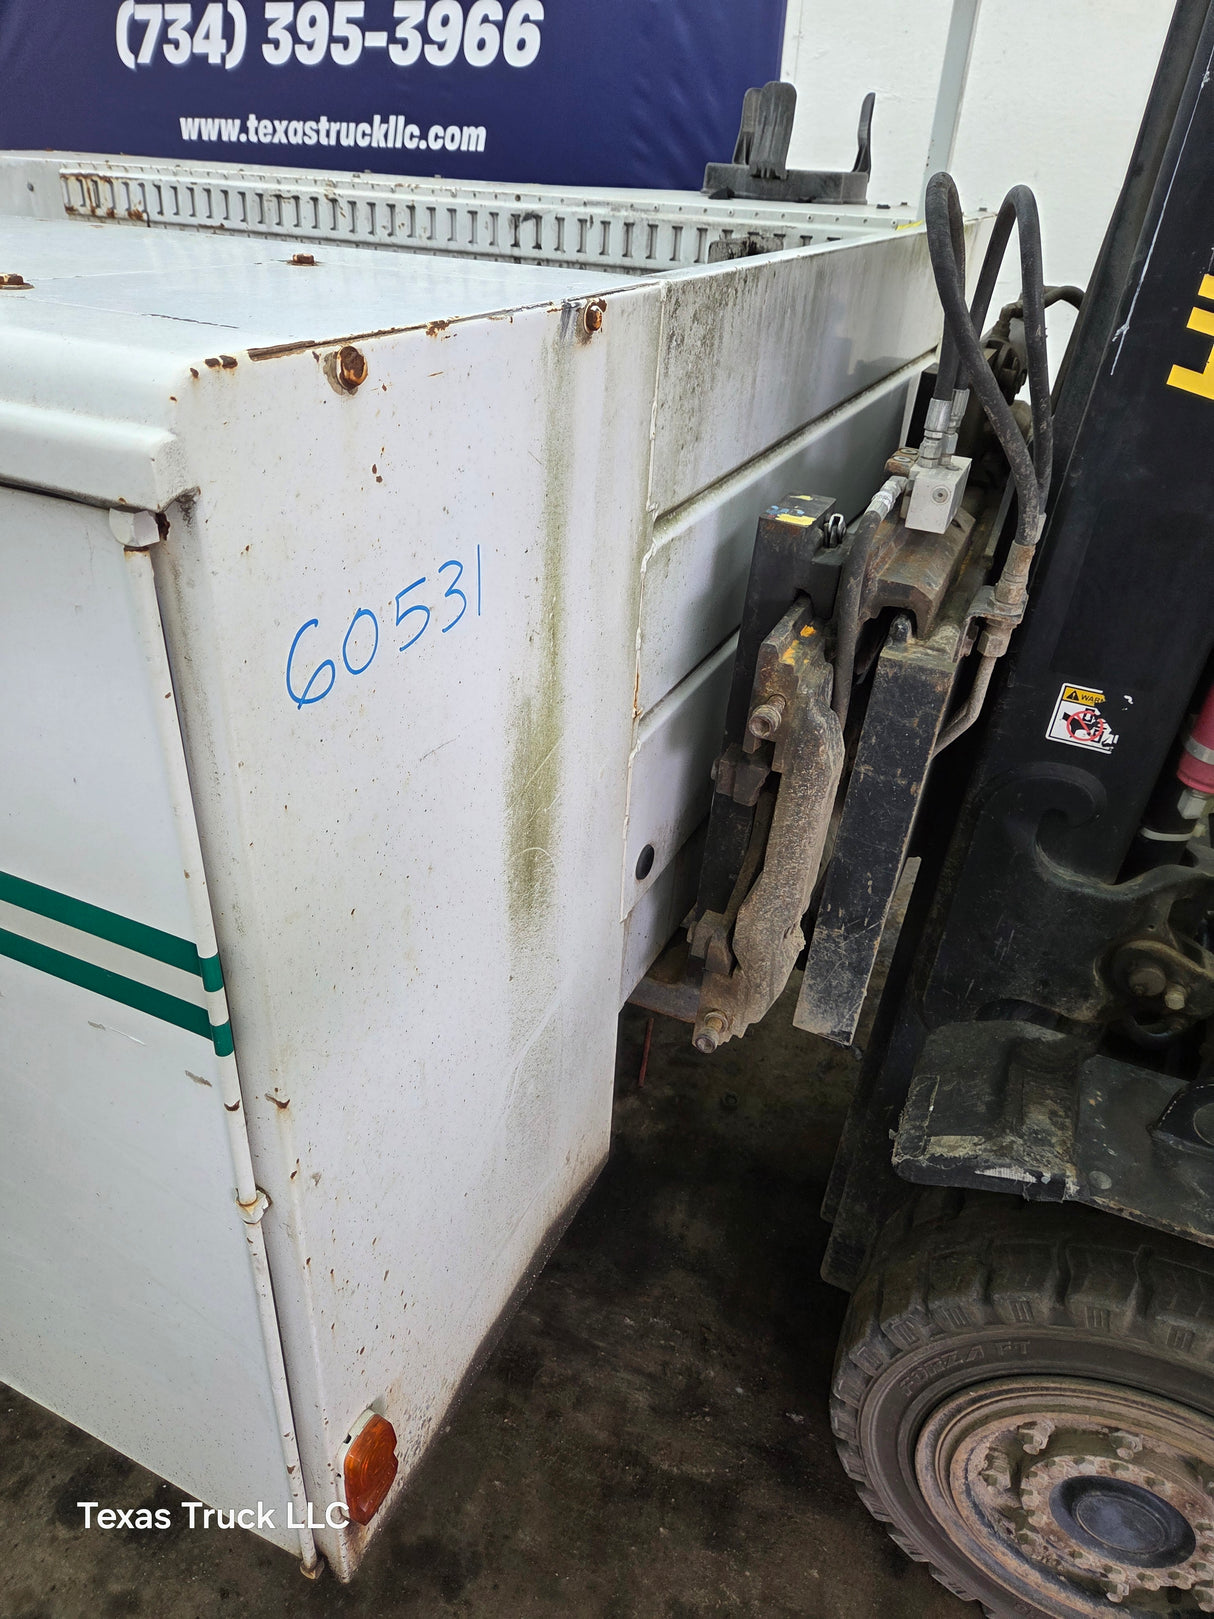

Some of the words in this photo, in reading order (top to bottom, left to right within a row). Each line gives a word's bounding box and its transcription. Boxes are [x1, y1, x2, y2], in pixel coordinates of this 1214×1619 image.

[115, 0, 247, 70] (734)
[262, 0, 544, 67] 395-3966
[179, 114, 487, 152] www.texastruckllc.com
[286, 544, 481, 710] 60531
